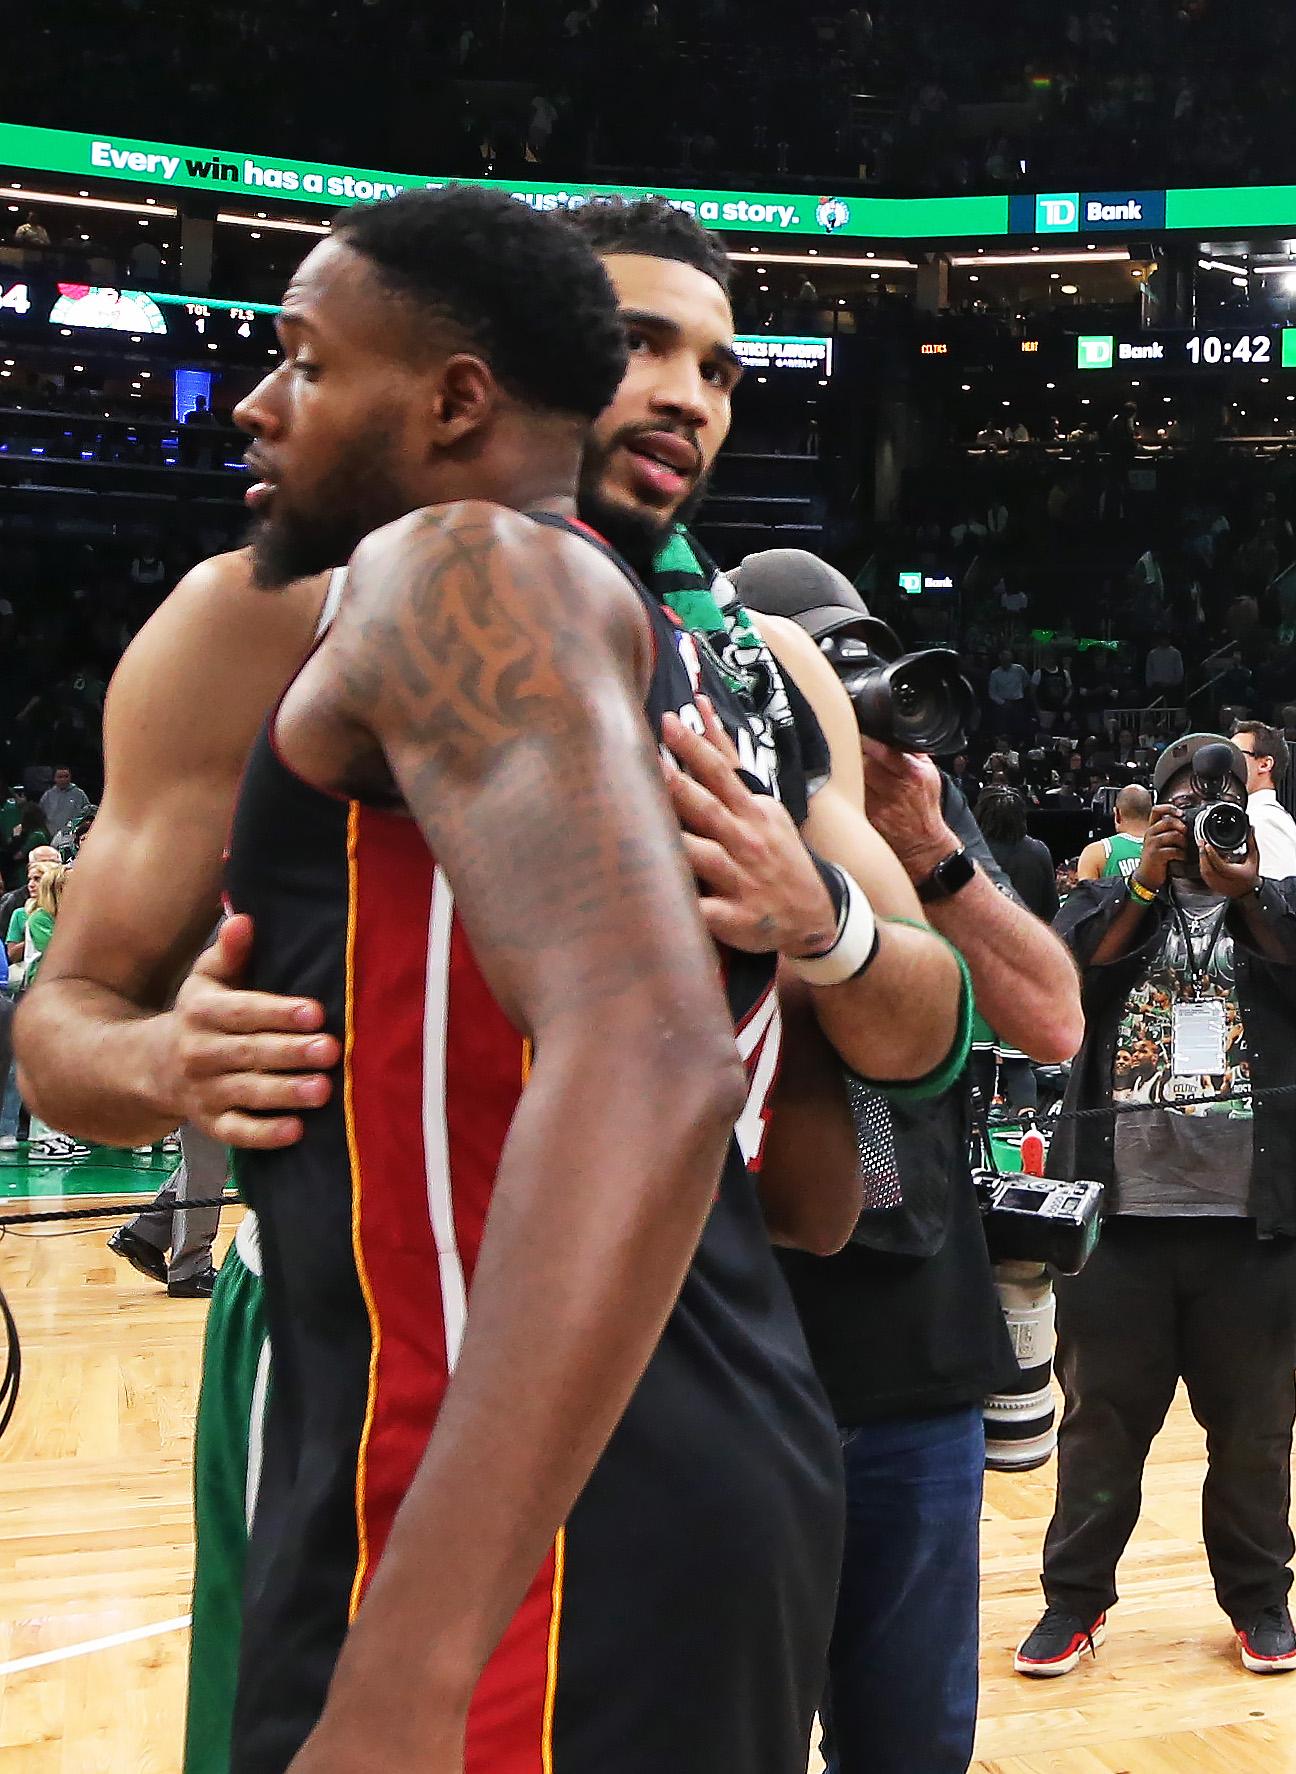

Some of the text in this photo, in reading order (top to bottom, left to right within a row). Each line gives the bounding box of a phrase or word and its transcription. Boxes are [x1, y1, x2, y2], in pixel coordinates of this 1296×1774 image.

[91, 141, 180, 179] Every
[186, 157, 238, 182] win
[244, 160, 299, 189] has
[303, 173, 324, 193] a
[700, 201, 719, 220] a
[722, 200, 800, 228] story.
[1040, 200, 1142, 225] TD Bank
[238, 322, 251, 338] 4
[1081, 341, 1164, 363] TD Bank
[1186, 335, 1271, 364] 10:42
[924, 576, 953, 588] Bank
